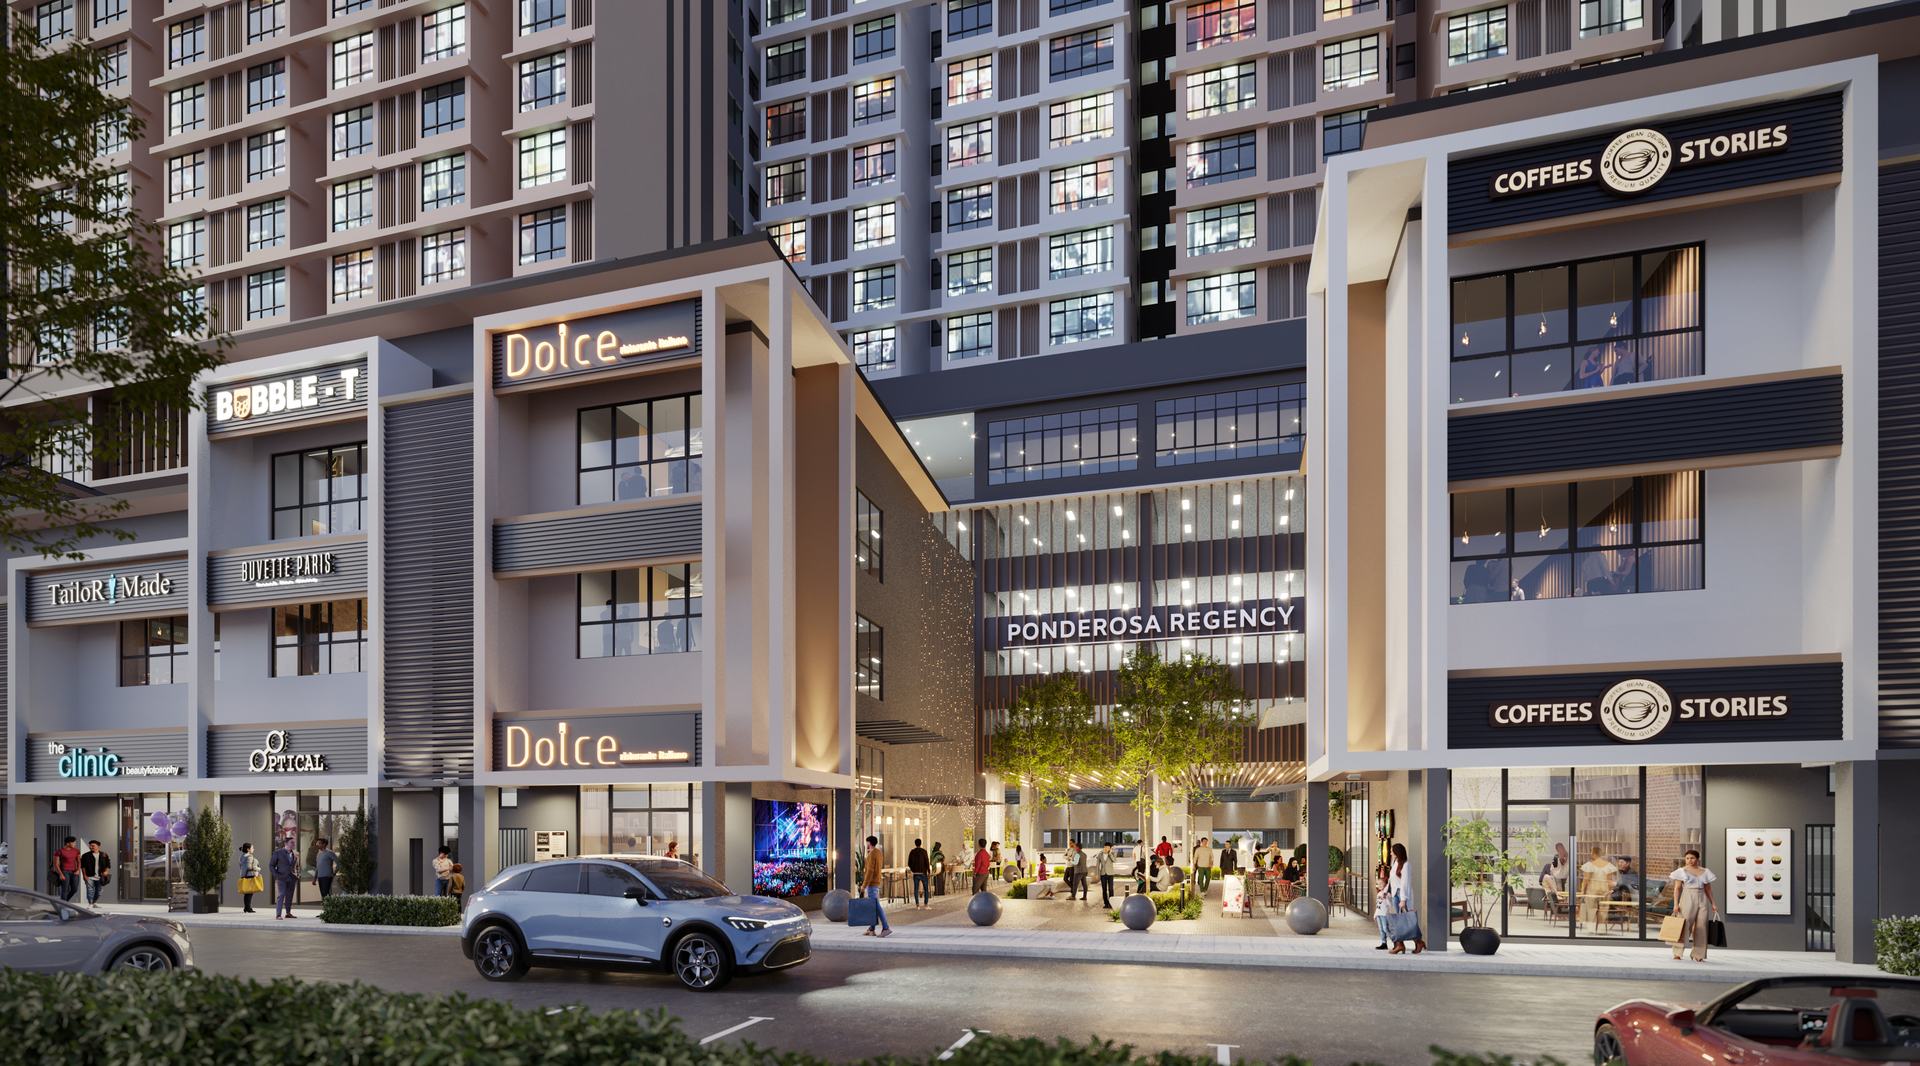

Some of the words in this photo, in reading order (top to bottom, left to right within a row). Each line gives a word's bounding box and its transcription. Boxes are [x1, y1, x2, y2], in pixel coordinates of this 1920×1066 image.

[1494, 159, 1593, 193] COFFEES
[1680, 125, 1788, 163] STORIES
[507, 323, 617, 377] Dolce
[340, 368, 359, 400] T
[241, 557, 290, 582] BUVETTE
[297, 552, 331, 576] PARIS
[48, 579, 105, 605] TailoR
[121, 572, 170, 598] Made
[1007, 614, 1162, 642] PONDEROSA
[1170, 605, 1295, 632] REGENCY
[1494, 702, 1593, 724] COFFEES
[1680, 695, 1788, 719] STORIES
[48, 741, 65, 754] the
[249, 749, 324, 772] OPTICAL
[507, 722, 617, 767] Dolce
[58, 747, 118, 778] clinic
